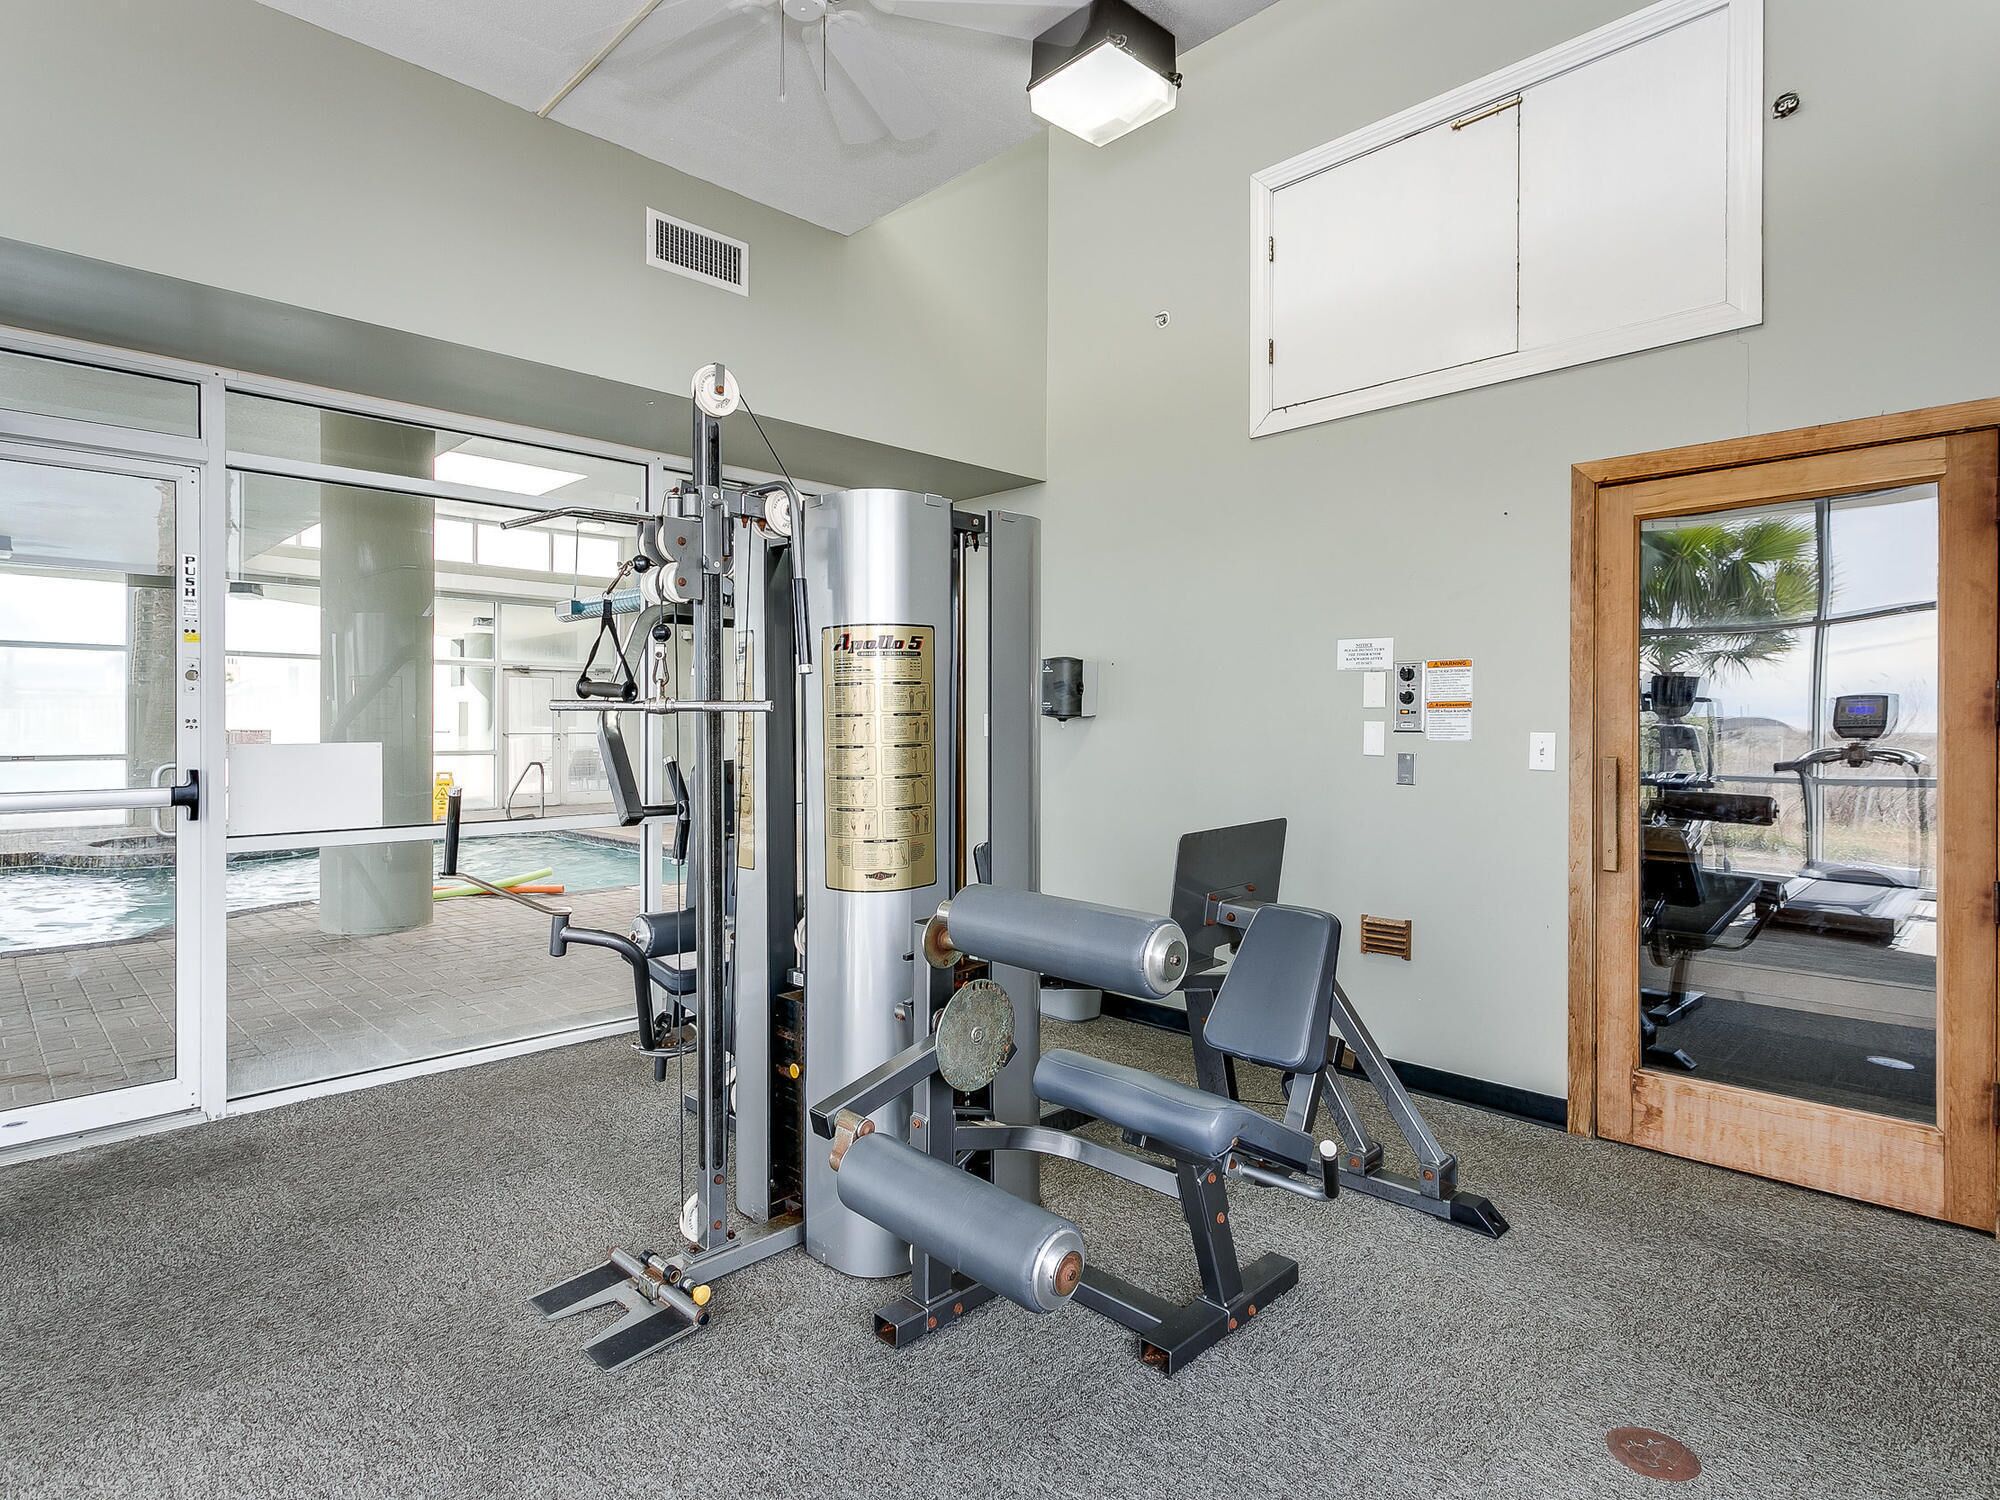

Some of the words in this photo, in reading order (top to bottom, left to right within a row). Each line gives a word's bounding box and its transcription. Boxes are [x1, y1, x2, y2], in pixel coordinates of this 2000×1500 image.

[184, 556, 196, 597] PUSH
[833, 632, 905, 654] Apollo
[907, 635, 925, 650] 5
